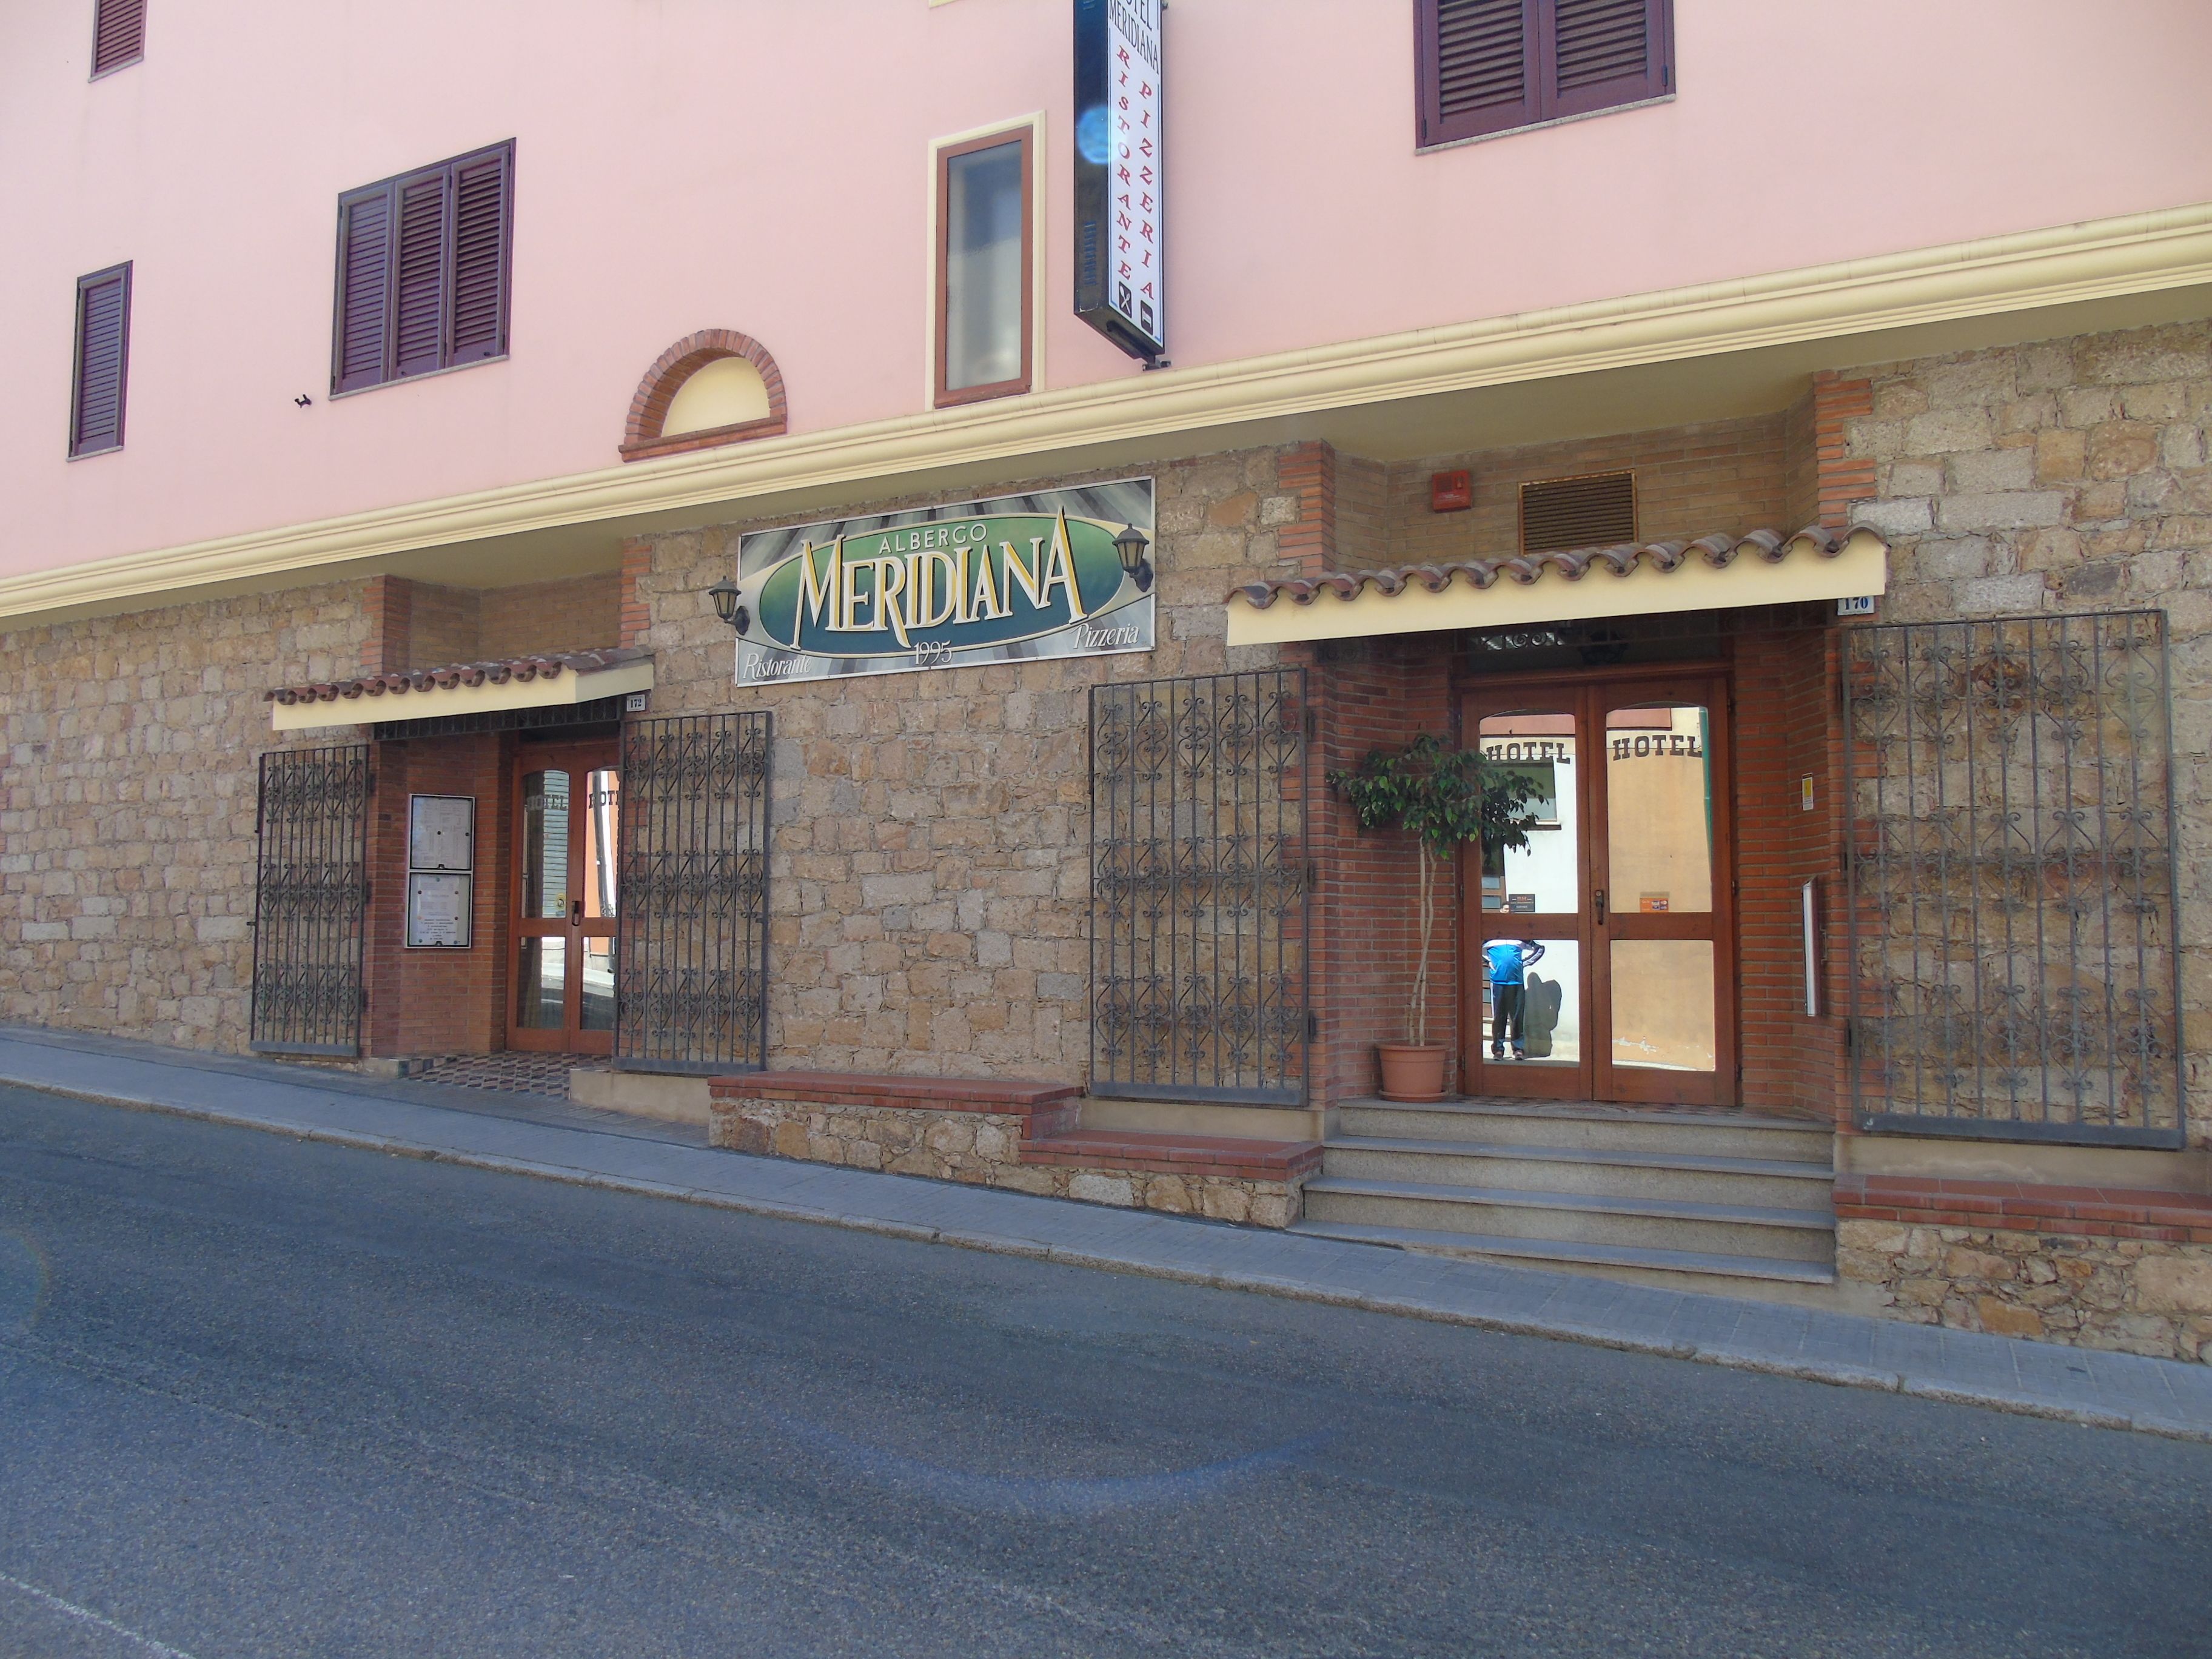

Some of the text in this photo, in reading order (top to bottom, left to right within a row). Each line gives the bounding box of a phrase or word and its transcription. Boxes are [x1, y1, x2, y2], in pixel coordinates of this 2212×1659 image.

[1109, 0, 1159, 75] MERIDIANA
[1116, 45, 1132, 280] RISTORANTE
[1139, 81, 1155, 300] PIZZERIA
[879, 523, 987, 555] ALBERGO
[789, 504, 1089, 651] MERIDIANA
[1845, 597, 1868, 610] 170
[1068, 623, 1140, 649] Pizzeria
[742, 652, 811, 680] Ristorante
[913, 640, 953, 665] 1995
[631, 698, 642, 708] 172
[1486, 742, 1570, 765] HOTEL
[1612, 734, 1703, 761] HOTEL
[526, 794, 568, 811] HOTEL
